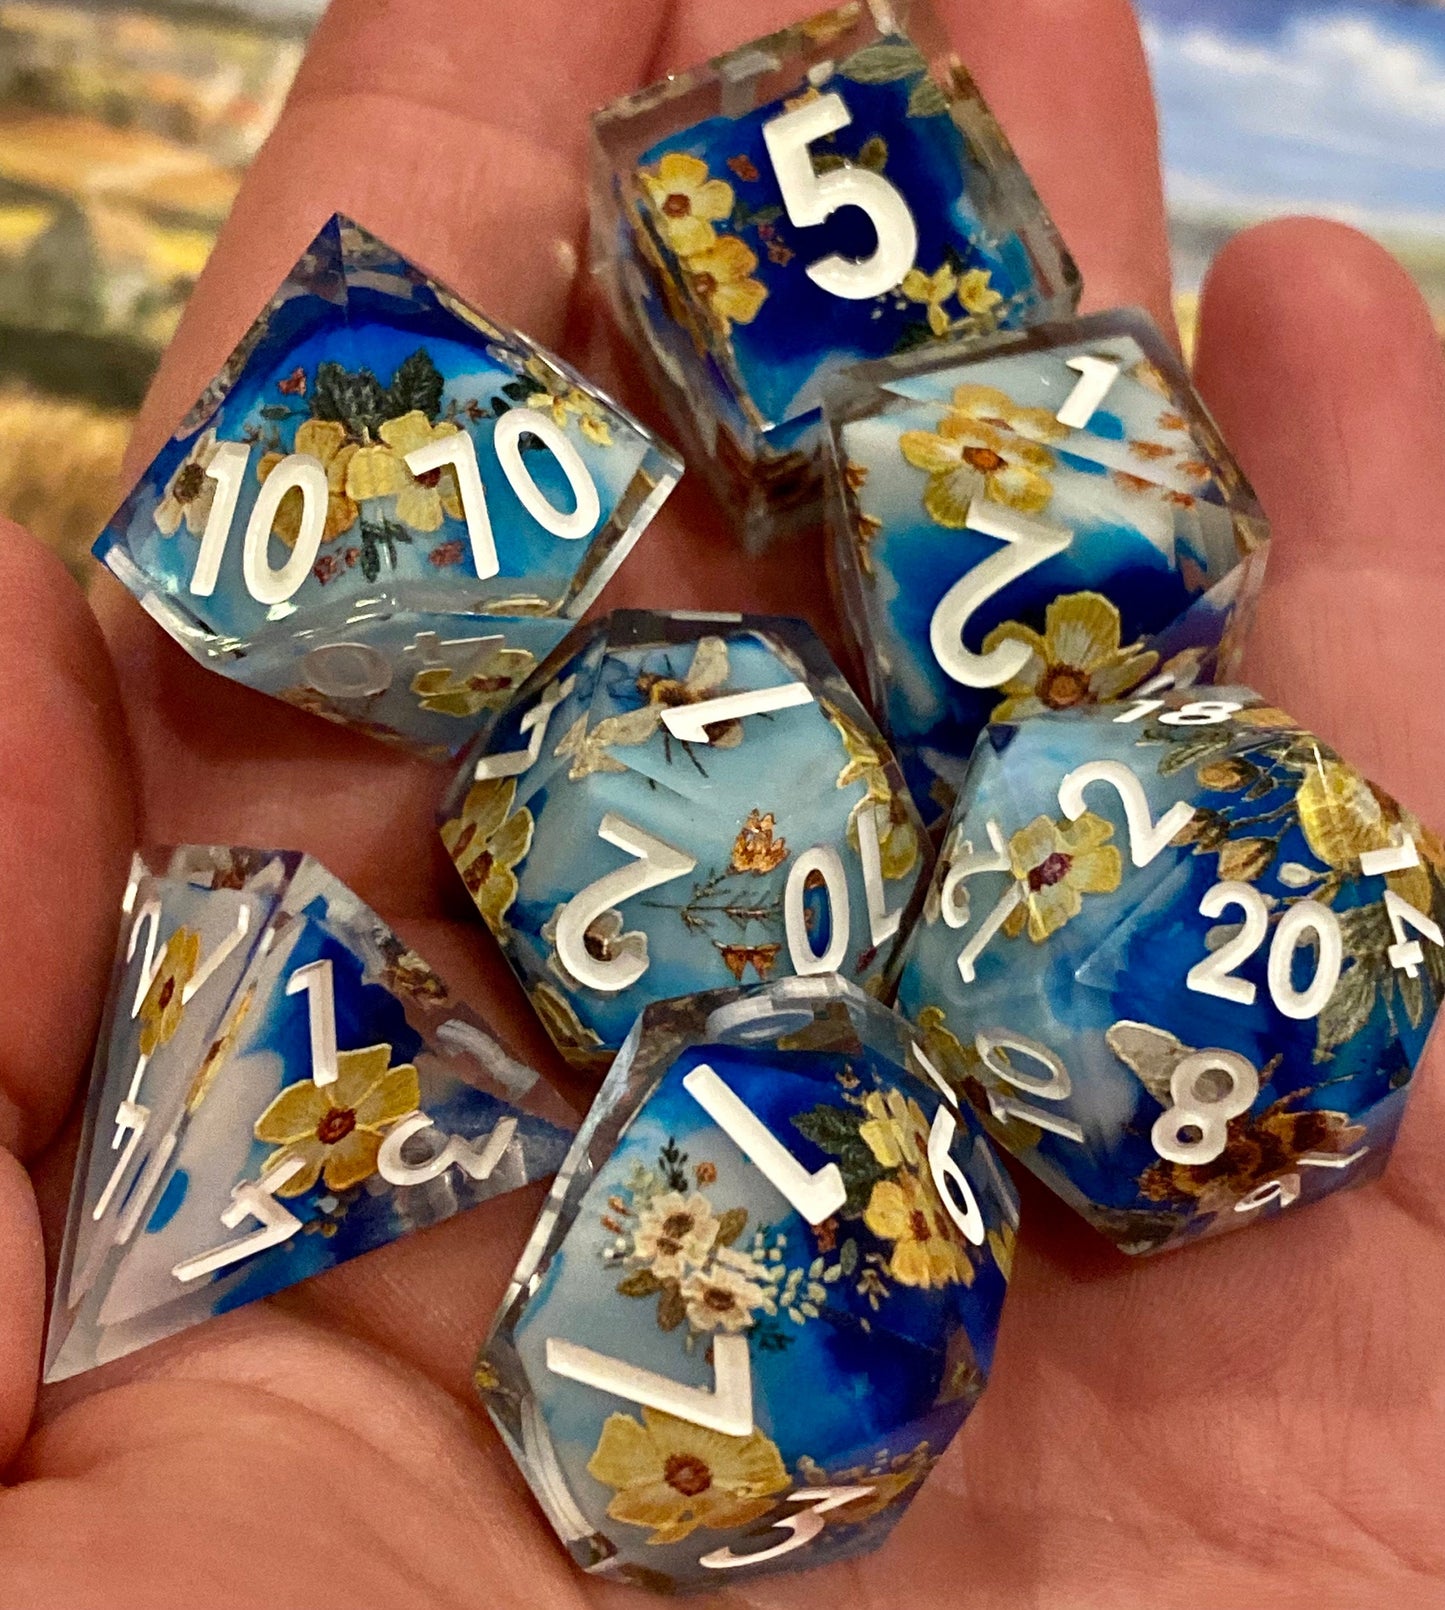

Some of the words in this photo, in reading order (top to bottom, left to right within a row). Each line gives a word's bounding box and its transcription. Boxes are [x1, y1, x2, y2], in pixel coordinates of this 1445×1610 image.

[762, 92, 918, 299] 5
[1056, 355, 1119, 429] 1
[189, 441, 329, 604] 10
[404, 407, 602, 580] 70
[929, 500, 1074, 689] 2
[659, 682, 815, 744] 1
[1112, 699, 1244, 725] 18
[1057, 759, 1197, 868] 2
[555, 813, 697, 991] 2
[1186, 879, 1343, 1020] 20
[286, 959, 338, 1088] 1
[682, 1063, 848, 1226] 1
[976, 1027, 1085, 1144] 10
[1151, 1047, 1260, 1165] 8
[377, 1109, 518, 1186] 3
[545, 1333, 753, 1437] 7
[700, 1486, 877, 1569] 3
